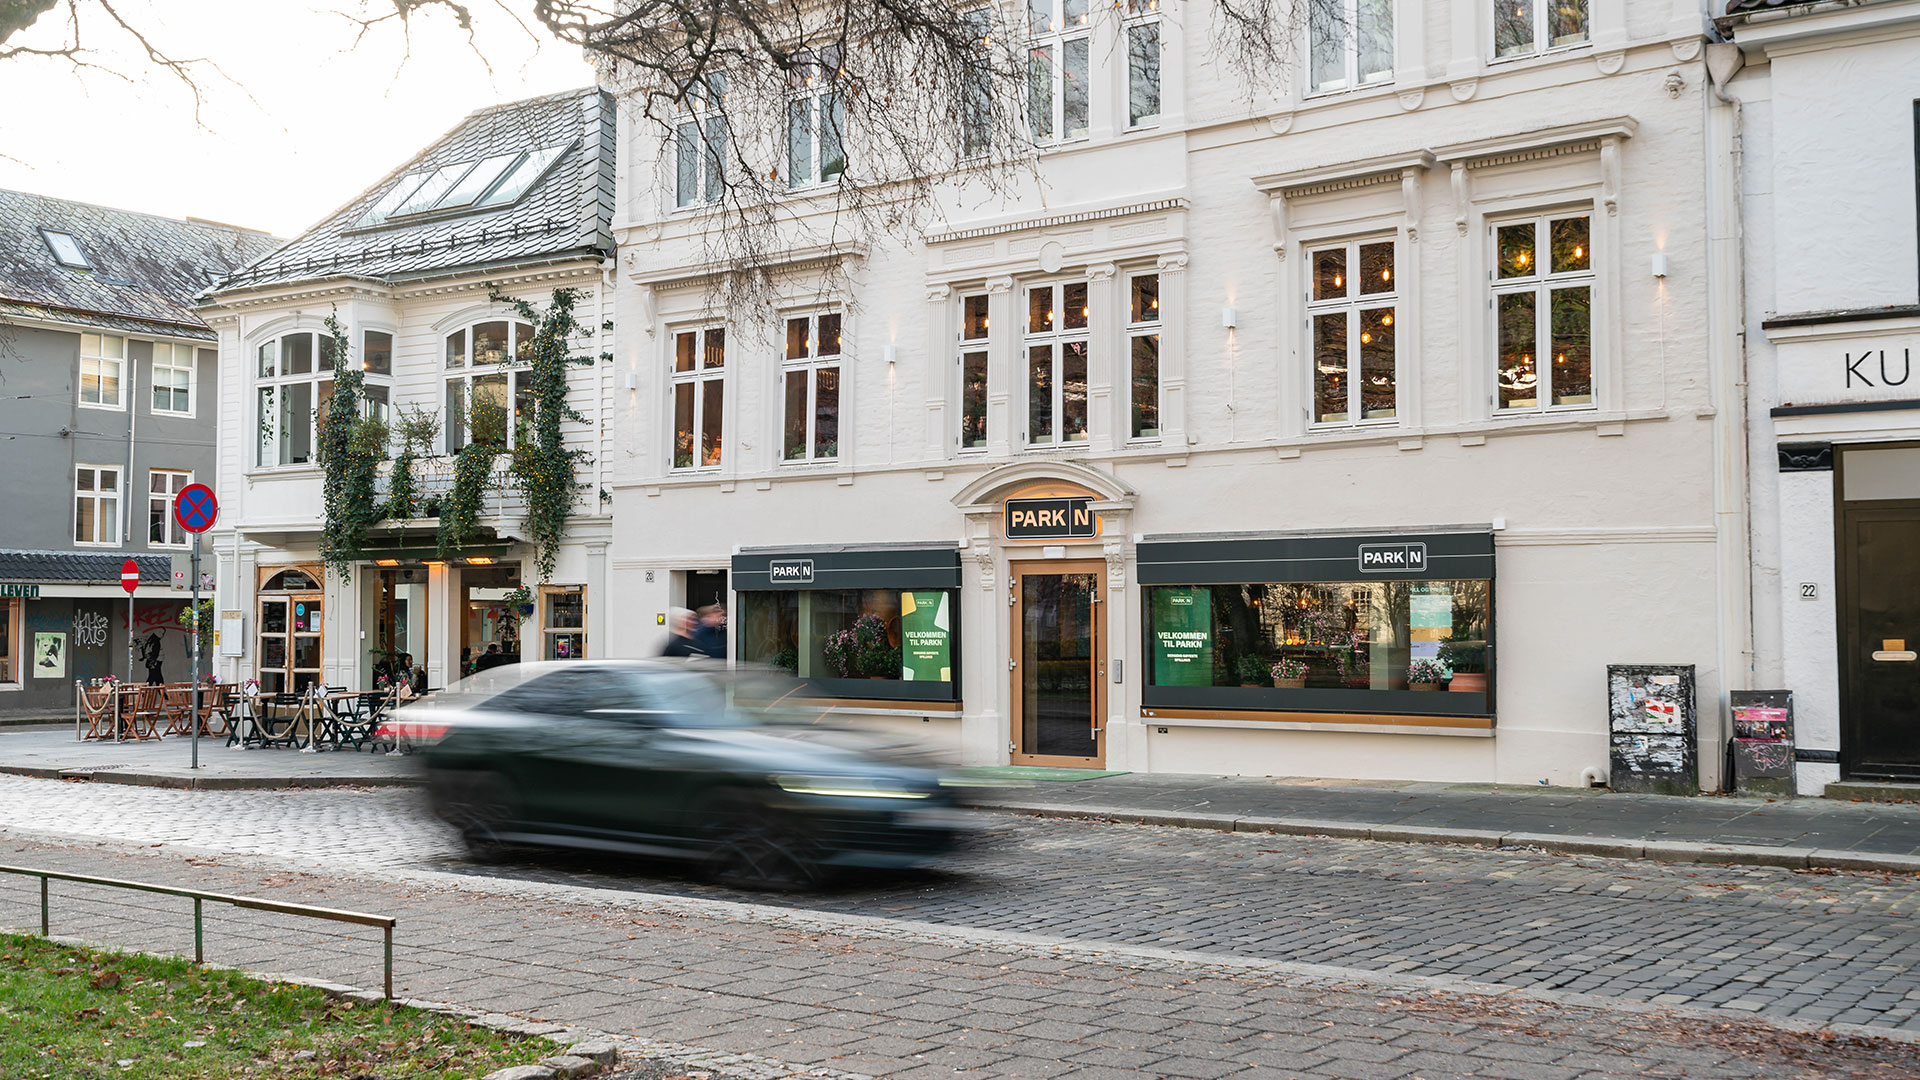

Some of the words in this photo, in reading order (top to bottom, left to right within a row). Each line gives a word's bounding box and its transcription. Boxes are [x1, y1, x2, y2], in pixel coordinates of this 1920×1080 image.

[1845, 348, 1910, 389] KU
[1011, 508, 1067, 528] PARK
[1074, 508, 1089, 526] N
[1363, 551, 1405, 564] PARK
[1409, 551, 1422, 563] N
[773, 566, 800, 577] PARK
[802, 566, 811, 576] N
[1801, 584, 1816, 598] 22
[905, 631, 947, 639] VELKOMMEN
[1157, 631, 1208, 640] VELKOMMEN
[1162, 640, 1175, 648] TIL
[1175, 640, 1203, 649] PARKN
